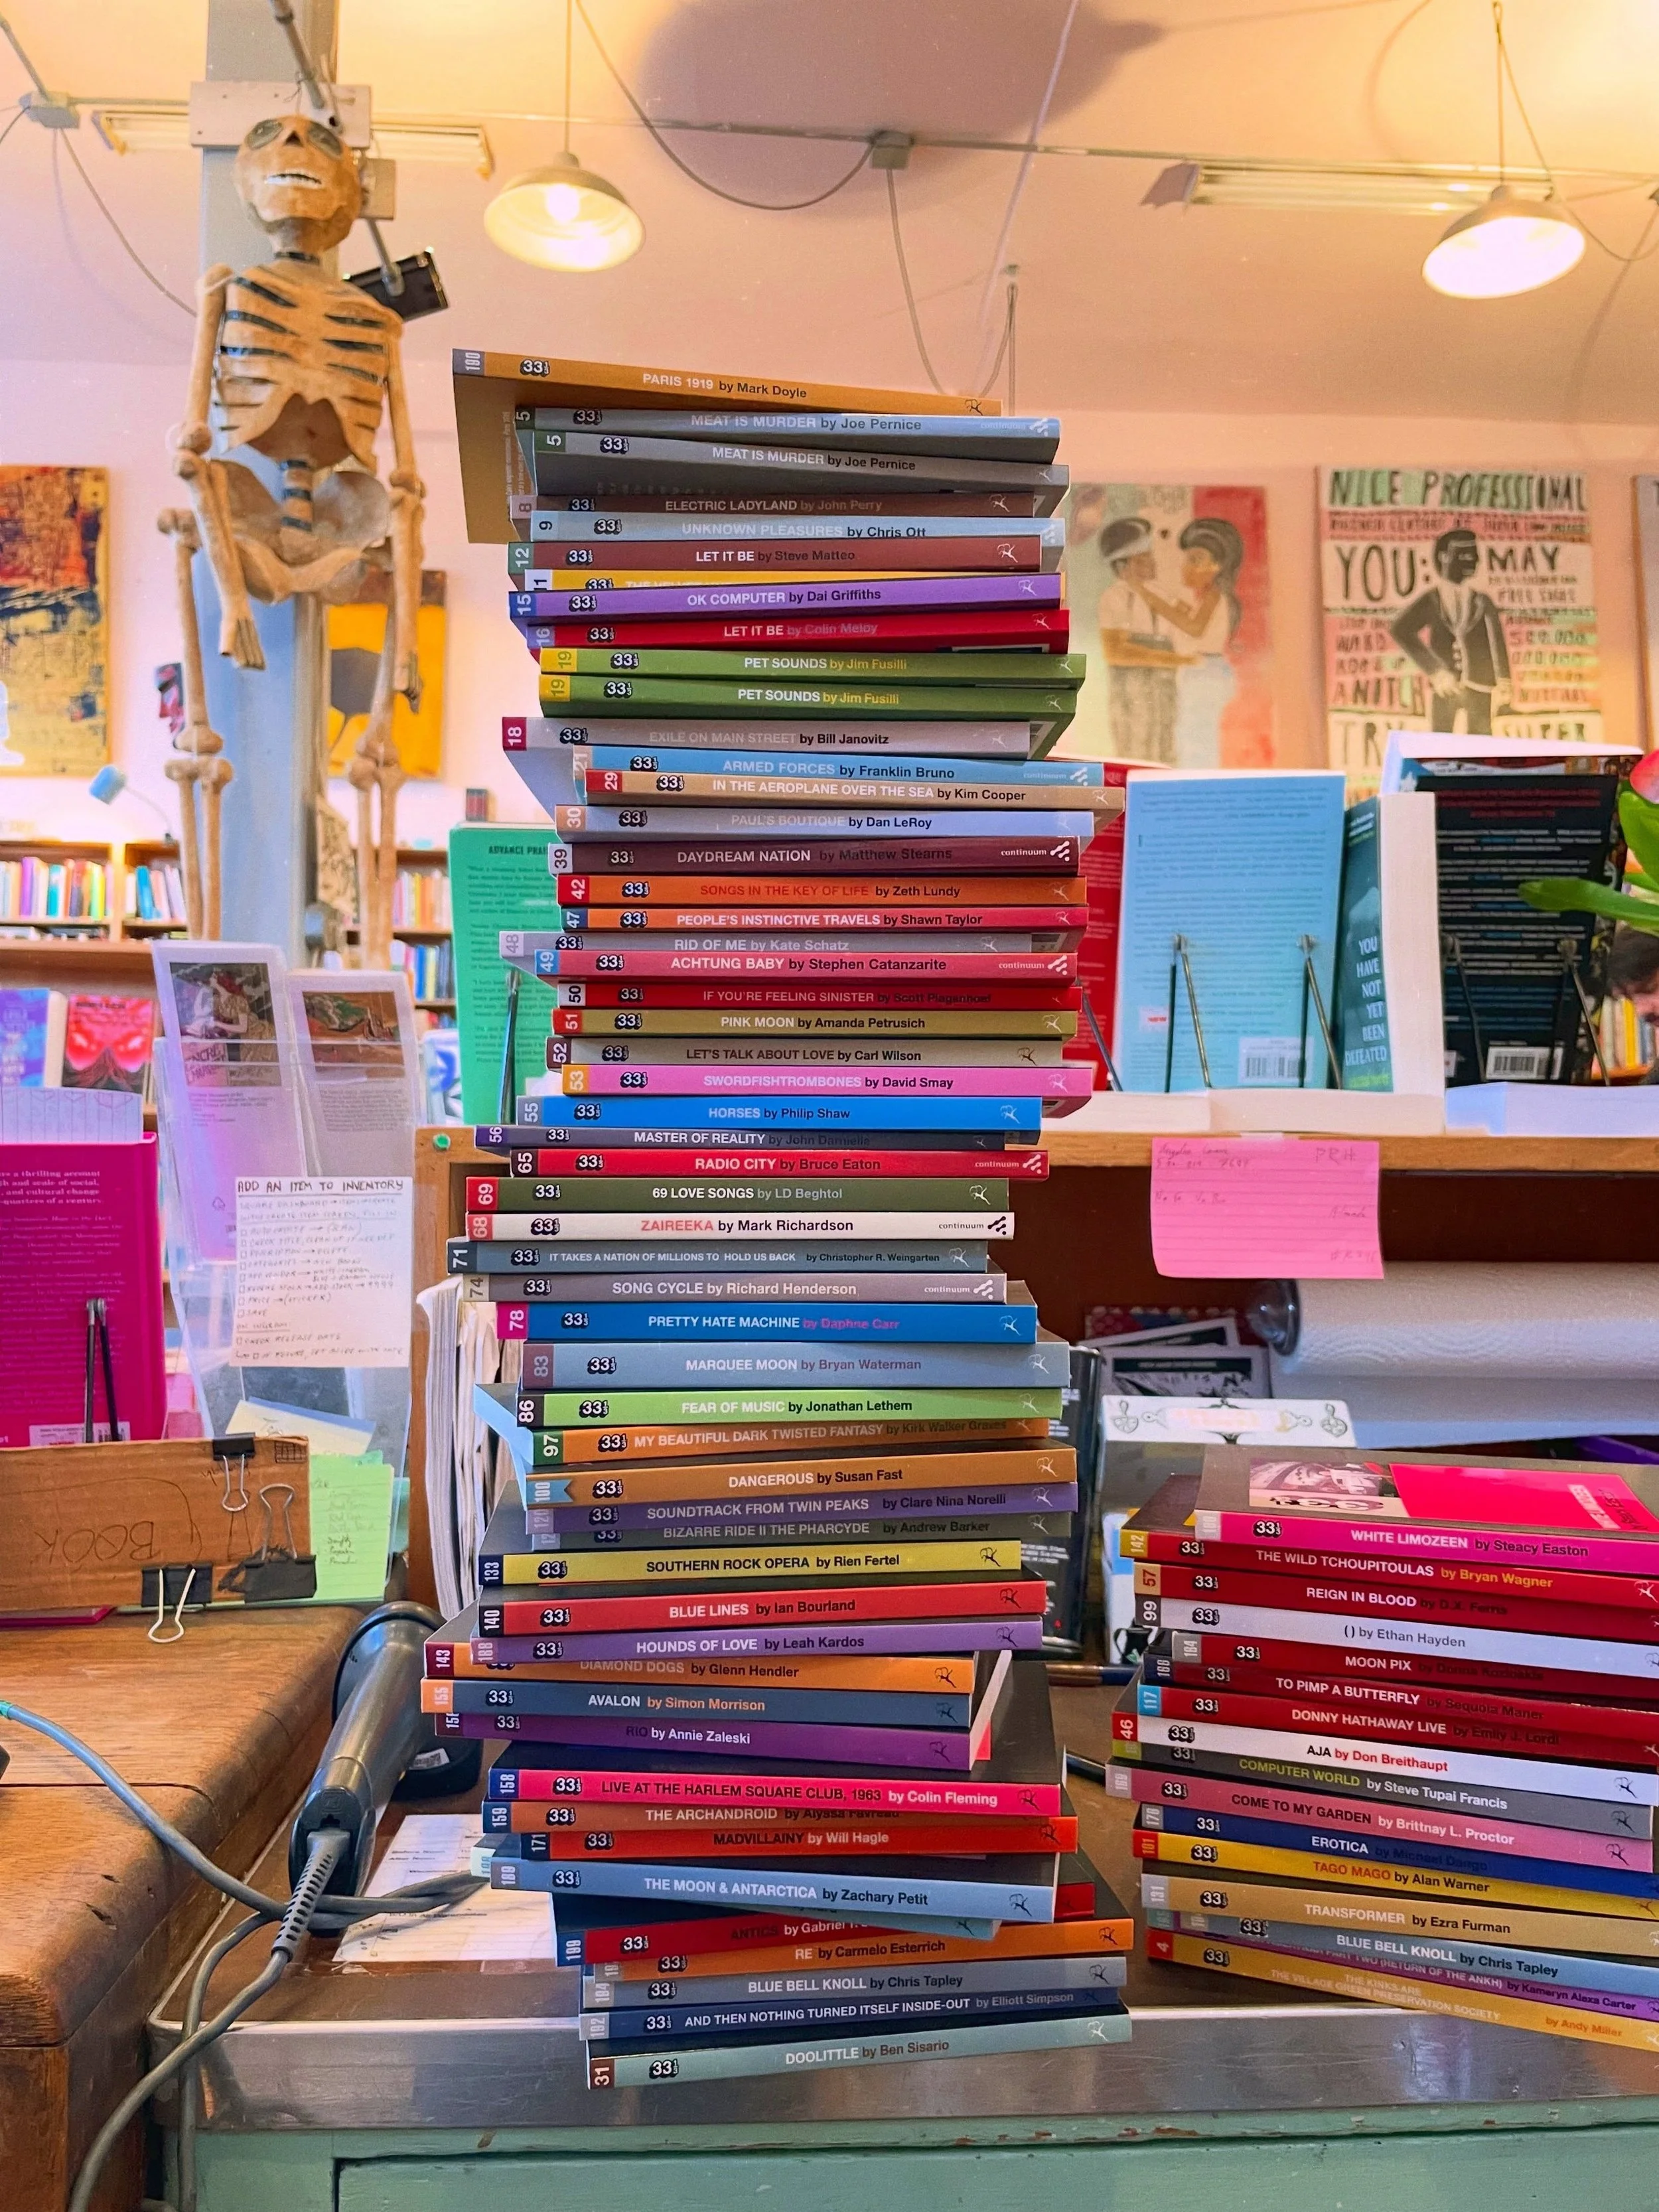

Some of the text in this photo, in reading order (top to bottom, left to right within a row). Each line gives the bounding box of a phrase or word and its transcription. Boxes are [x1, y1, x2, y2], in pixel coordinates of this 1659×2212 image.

[643, 373, 807, 400] PARIS 1919 by Mark Doyle
[1331, 470, 1401, 506] NICE
[1487, 547, 1561, 571] MAY
[518, 594, 532, 616] 15
[687, 588, 881, 606] OK COMPUTER by Dai Griffiths
[738, 690, 899, 705] PET SOUNDS by Jim Fusilli
[508, 726, 522, 747] 18
[800, 733, 889, 746] by Bill Janovitz
[713, 780, 1026, 802] IN THE AEROPLANE OVER THE SEA by Kim Cooper
[554, 849, 568, 868] 39
[678, 849, 811, 863] DAYDREAM NATION
[571, 879, 585, 899] 42
[1358, 936, 1378, 956] YOU
[670, 957, 741, 970] ACHTUNG
[745, 957, 784, 970] BABY
[788, 958, 804, 972] by
[809, 958, 864, 972] Stephen
[869, 959, 946, 972] Catanzarite
[1356, 956, 1380, 978] HAVE
[569, 985, 582, 1003] 50
[1362, 979, 1382, 998] NOT
[1366, 1001, 1383, 1019] YET
[721, 1017, 925, 1029] PINK MOON by Amanda Petrusich
[1362, 1023, 1385, 1043] BEEN
[703, 1075, 954, 1090] SWORDFISHTROMBONES by David Smay
[518, 1153, 532, 1173] 65
[695, 1158, 740, 1170] RADIO
[743, 1158, 776, 1170] CITY
[780, 1158, 795, 1171] by
[799, 1159, 839, 1171] Bruce
[843, 1159, 881, 1171] Eaton
[238, 1180, 403, 1193] ADD AN ITEM TO INVENTORY
[479, 1183, 493, 1205] 69
[641, 1219, 714, 1232] ZAIREEKA
[718, 1220, 734, 1234] by
[738, 1220, 772, 1231] Mark
[776, 1220, 853, 1231] Richardson
[613, 1283, 654, 1295] SONG
[657, 1282, 703, 1295] CYCLE
[707, 1283, 723, 1296] by
[727, 1283, 779, 1295] Richard
[783, 1283, 857, 1295] Henderson
[510, 1309, 524, 1331] 78
[519, 1400, 534, 1422] 86
[543, 1435, 558, 1457] 97
[729, 1468, 902, 1488] DANGEROUS by Susan Fast
[1351, 1529, 1589, 1557] WHITE LIMOZEEN by Steacy Easton
[484, 1562, 499, 1581] 133
[646, 1554, 900, 1573] SOUTHERN ROCK OPERA by Rien Fertel
[669, 1599, 855, 1619] BLUE LINES by Ian Bourland
[1143, 1601, 1157, 1621] 99
[484, 1610, 500, 1630] 140
[588, 1695, 765, 1711] AVALON by Simon Morrison
[1307, 1745, 1448, 1772] AJA by Don Breithaupt
[1239, 1758, 1311, 1779] COMPUTER
[1313, 1769, 1360, 1787] WORLD
[1367, 1777, 1382, 1792] by
[1384, 1780, 1419, 1797] Steve
[1460, 1791, 1508, 1810] Francis
[644, 1878, 928, 1905] THE MOON & ANTARCTICA by Zachary Petit
[1305, 1903, 1510, 1935] TRANSFORMER by Ezra Furman
[749, 1974, 962, 1994] BLUE BELL KNOLL by Chris Tapley
[786, 2039, 949, 2065] DOOLITTLE by Ben Sisario
[594, 2065, 610, 2085] 31
